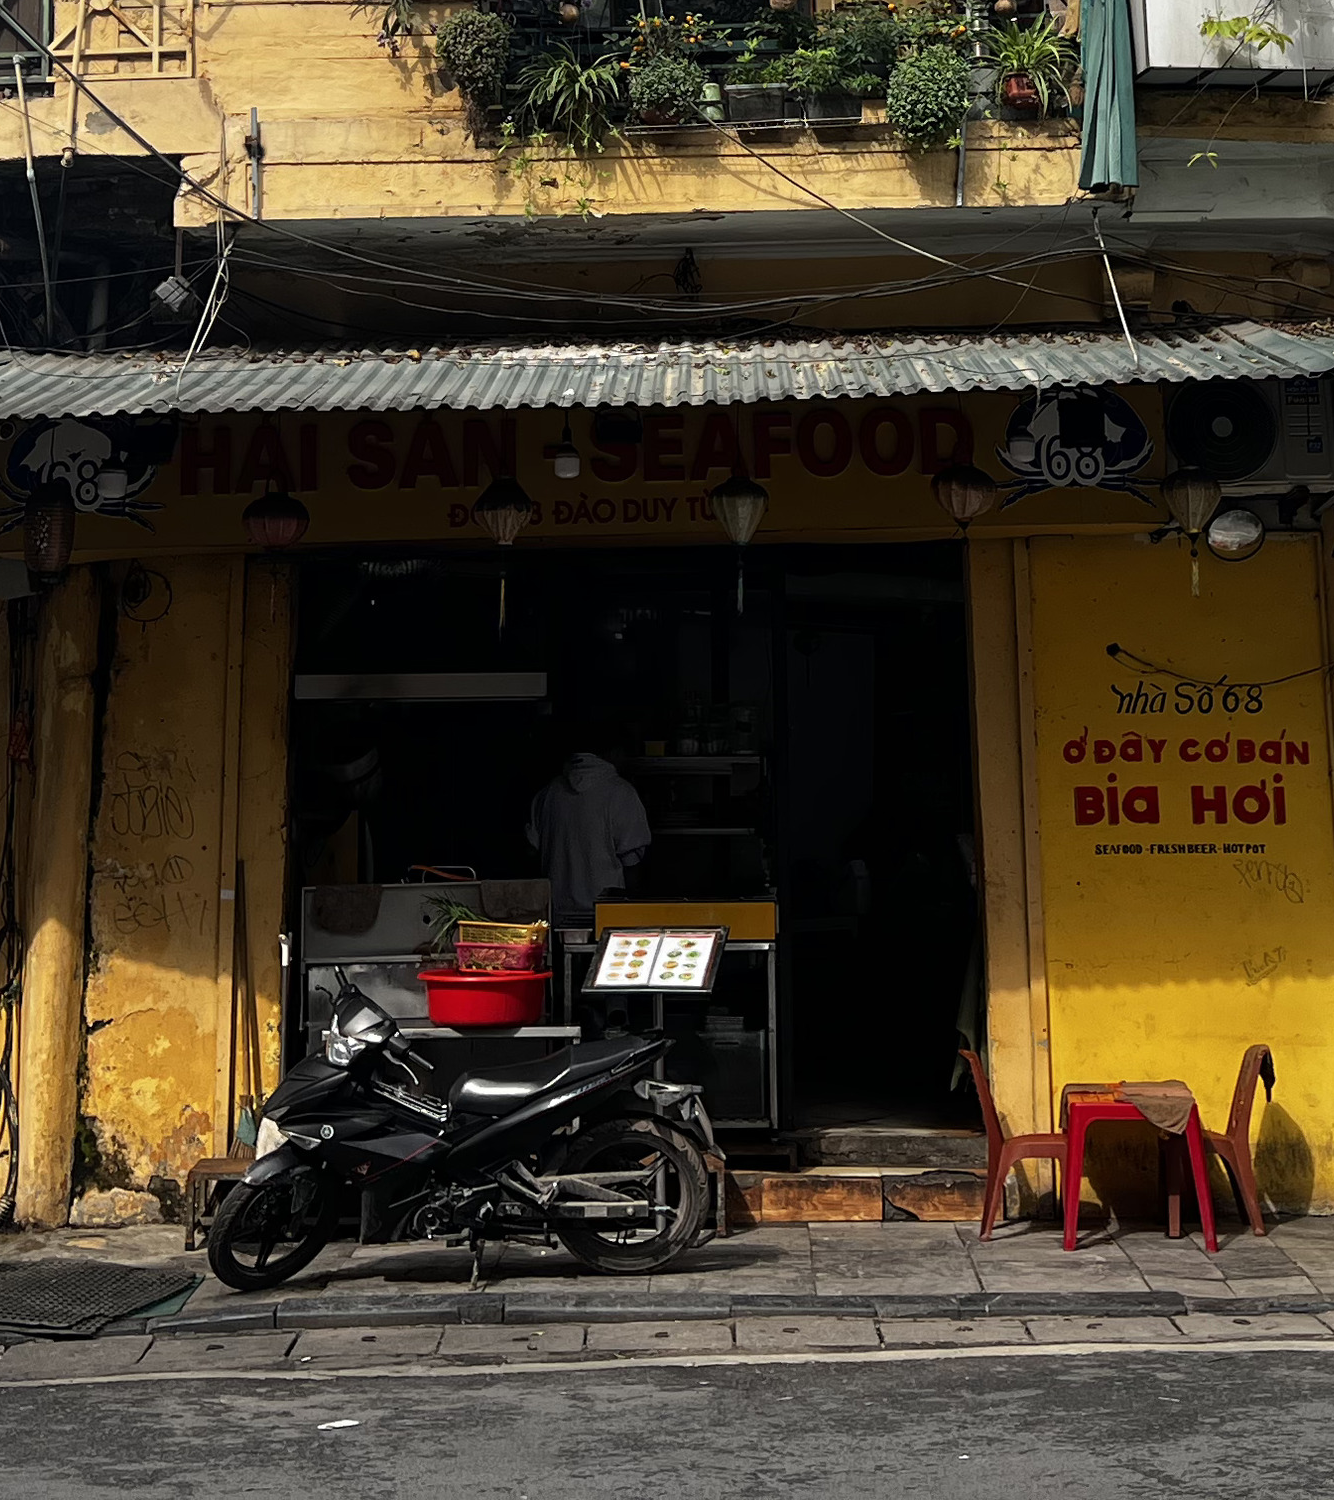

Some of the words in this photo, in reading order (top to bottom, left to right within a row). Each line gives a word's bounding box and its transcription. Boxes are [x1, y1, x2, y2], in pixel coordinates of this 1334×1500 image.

[551, 492, 616, 525] ĐÀO
[622, 497, 678, 524] DUY
[1222, 684, 1265, 714] 68
[1094, 843, 1143, 855] SEAFOOD
